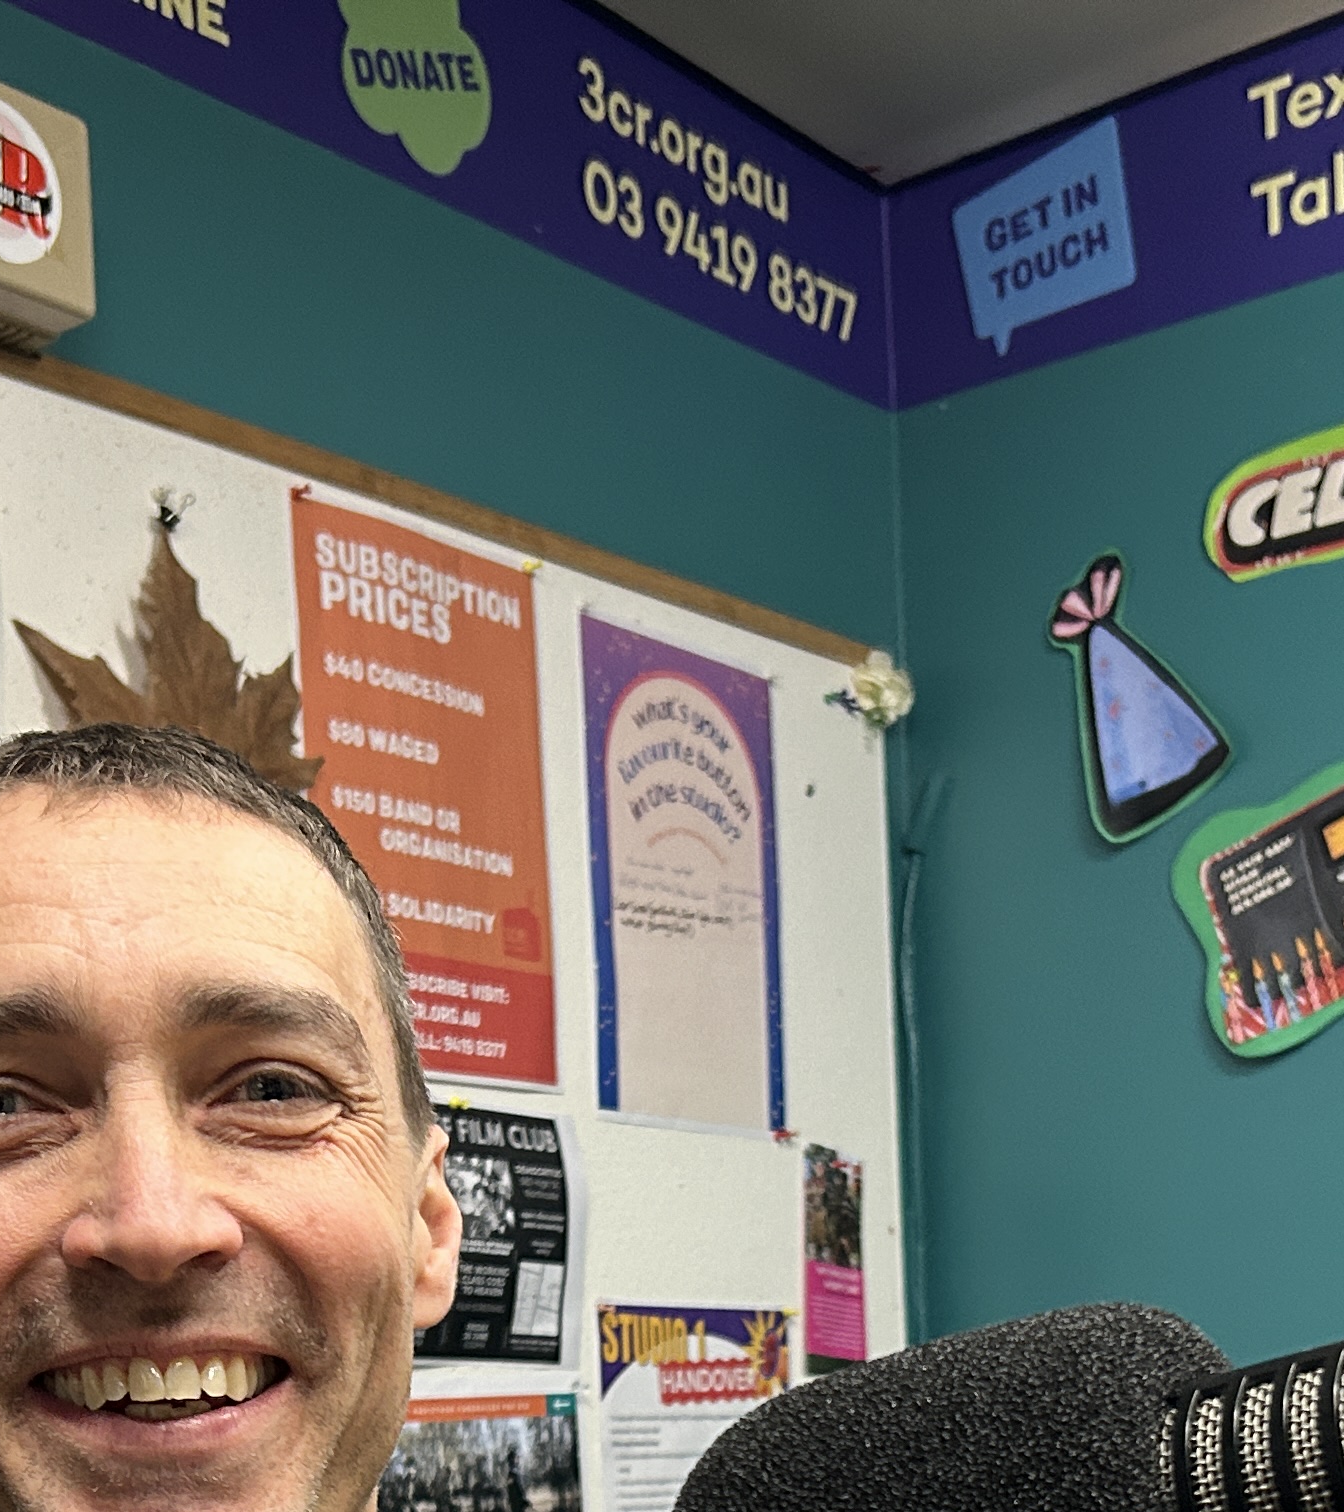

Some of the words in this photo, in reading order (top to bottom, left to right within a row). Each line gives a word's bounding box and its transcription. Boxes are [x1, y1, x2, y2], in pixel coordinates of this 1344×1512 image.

[350, 48, 481, 92] DONATE
[578, 57, 789, 224] 3cr.org.au
[984, 195, 1052, 252] GET
[1062, 173, 1099, 218] IN
[582, 159, 646, 239] 03
[655, 196, 758, 293] 9419
[767, 253, 857, 343] 8377
[990, 222, 1109, 298] TOUCH
[315, 532, 521, 629] SUBSCRIPTION
[320, 570, 451, 644] PRICES
[368, 662, 484, 717] CONCESSION
[369, 728, 439, 765] WAGED
[333, 786, 375, 814] $150
[380, 795, 432, 826] BAND
[437, 808, 460, 834] OR
[381, 828, 513, 877] ORGANISATION
[388, 893, 495, 934] SOLIDARITY
[456, 1118, 506, 1147] FILM
[508, 1125, 558, 1153] CLUB
[602, 1311, 688, 1366] STUDIO
[693, 1319, 706, 1363] 1
[661, 1366, 756, 1394] HANDOVER
